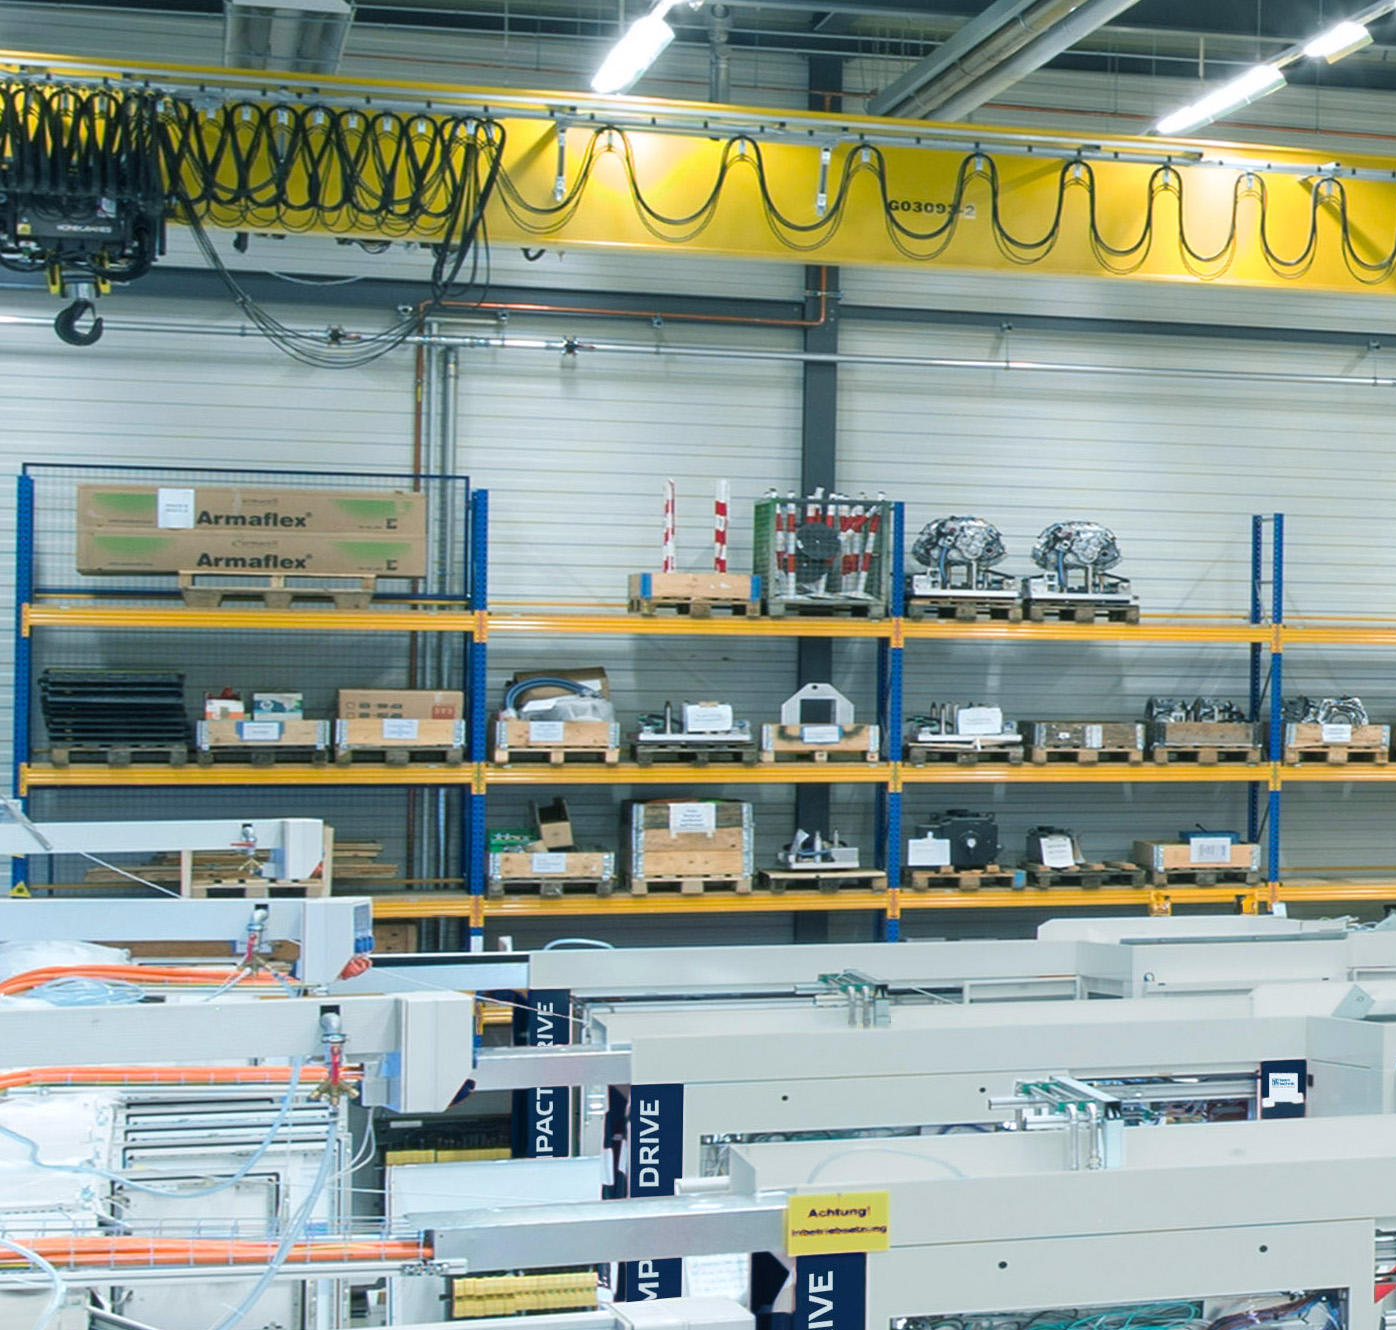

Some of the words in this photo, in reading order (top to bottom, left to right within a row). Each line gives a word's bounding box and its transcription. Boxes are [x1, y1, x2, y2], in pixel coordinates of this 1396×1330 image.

[536, 1002, 555, 1047] RIVE
[639, 1099, 660, 1188] DRIVE
[807, 1205, 872, 1218] Achtung!
